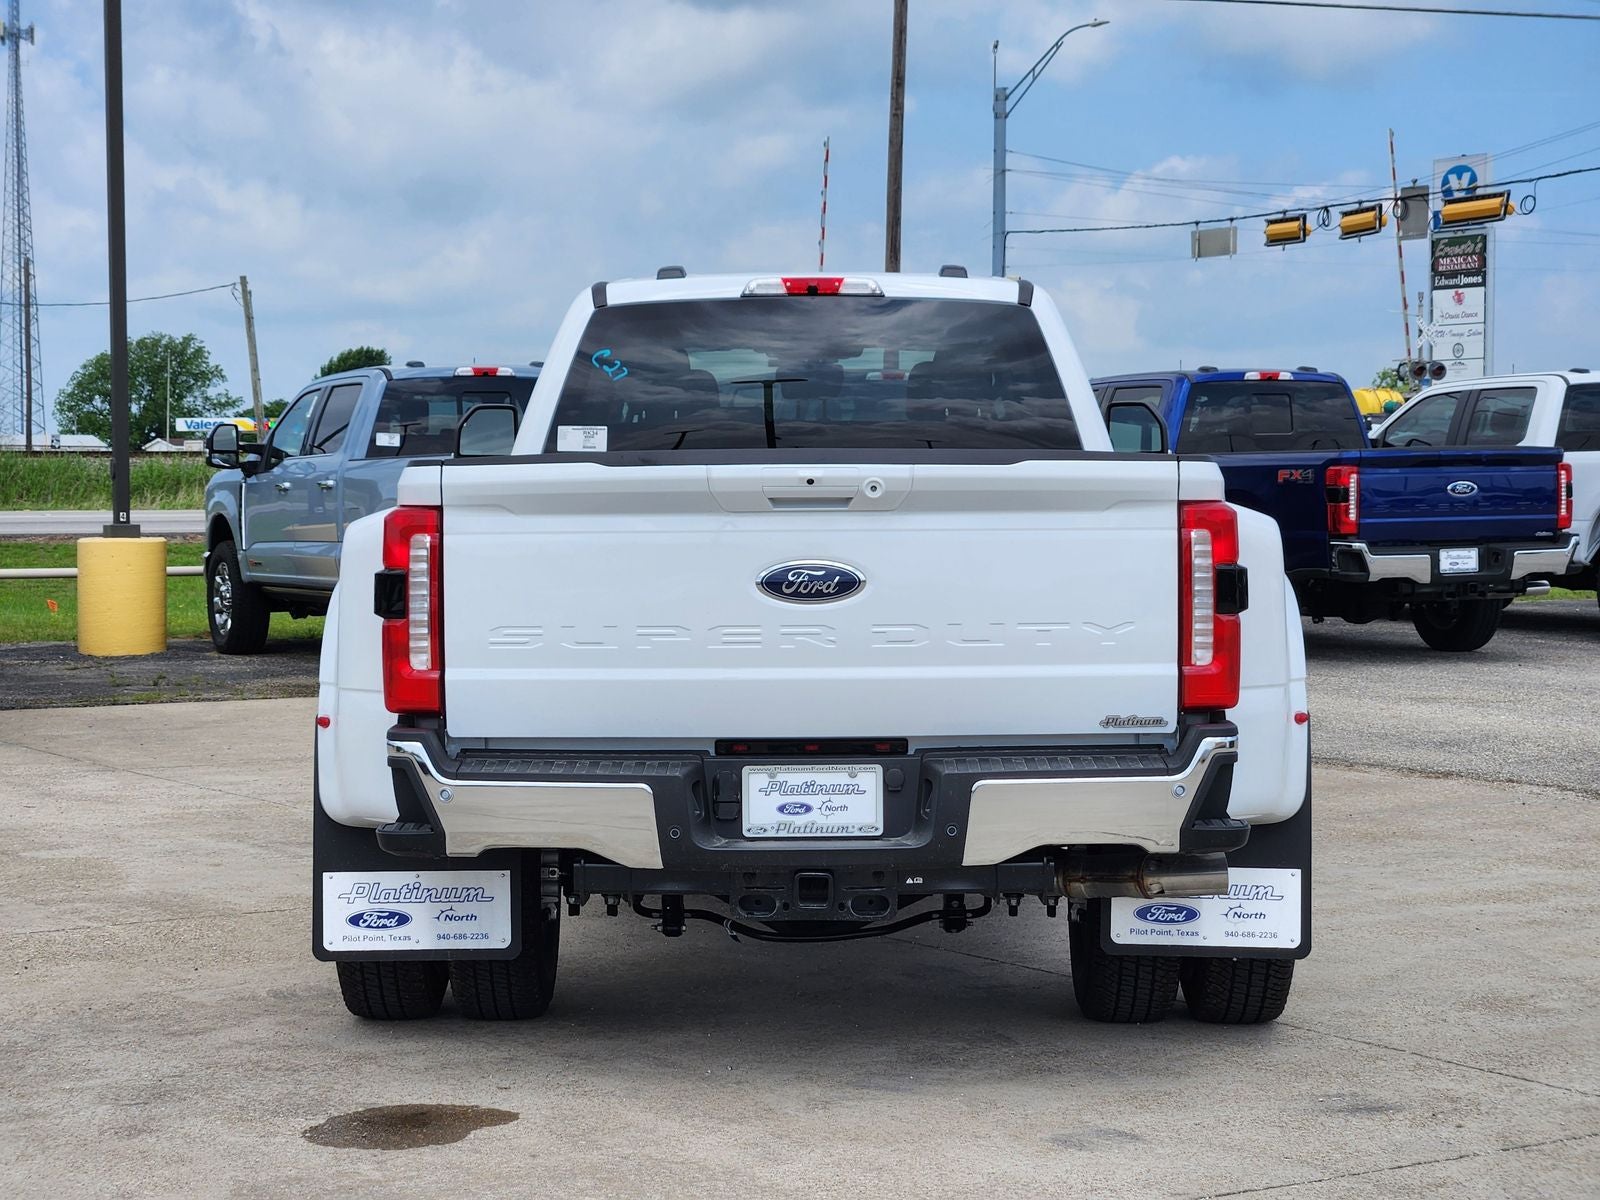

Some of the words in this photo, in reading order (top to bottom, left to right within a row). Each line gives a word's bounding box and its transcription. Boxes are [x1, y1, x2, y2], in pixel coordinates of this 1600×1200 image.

[1439, 255, 1478, 265] MEXICAN
[1438, 262, 1479, 271] RESTAURANT
[1277, 469, 1314, 483] FX4
[489, 624, 837, 648] SUPER
[871, 621, 1136, 648] DUTY
[1099, 714, 1169, 729] Platinum
[759, 780, 867, 796] Platinum
[825, 804, 849, 812] North
[776, 821, 855, 834] Platinum
[338, 881, 495, 904] Platinum
[444, 913, 477, 922] North
[1232, 911, 1267, 920] North
[436, 933, 489, 941] 940-686-2236
[1130, 928, 1149, 936] Pilot
[1150, 929, 1174, 937] Point,
[1176, 929, 1200, 937] Texas
[1224, 931, 1278, 939] 940-686-2236
[363, 935, 386, 943] Point,
[388, 934, 412, 942] Texas
